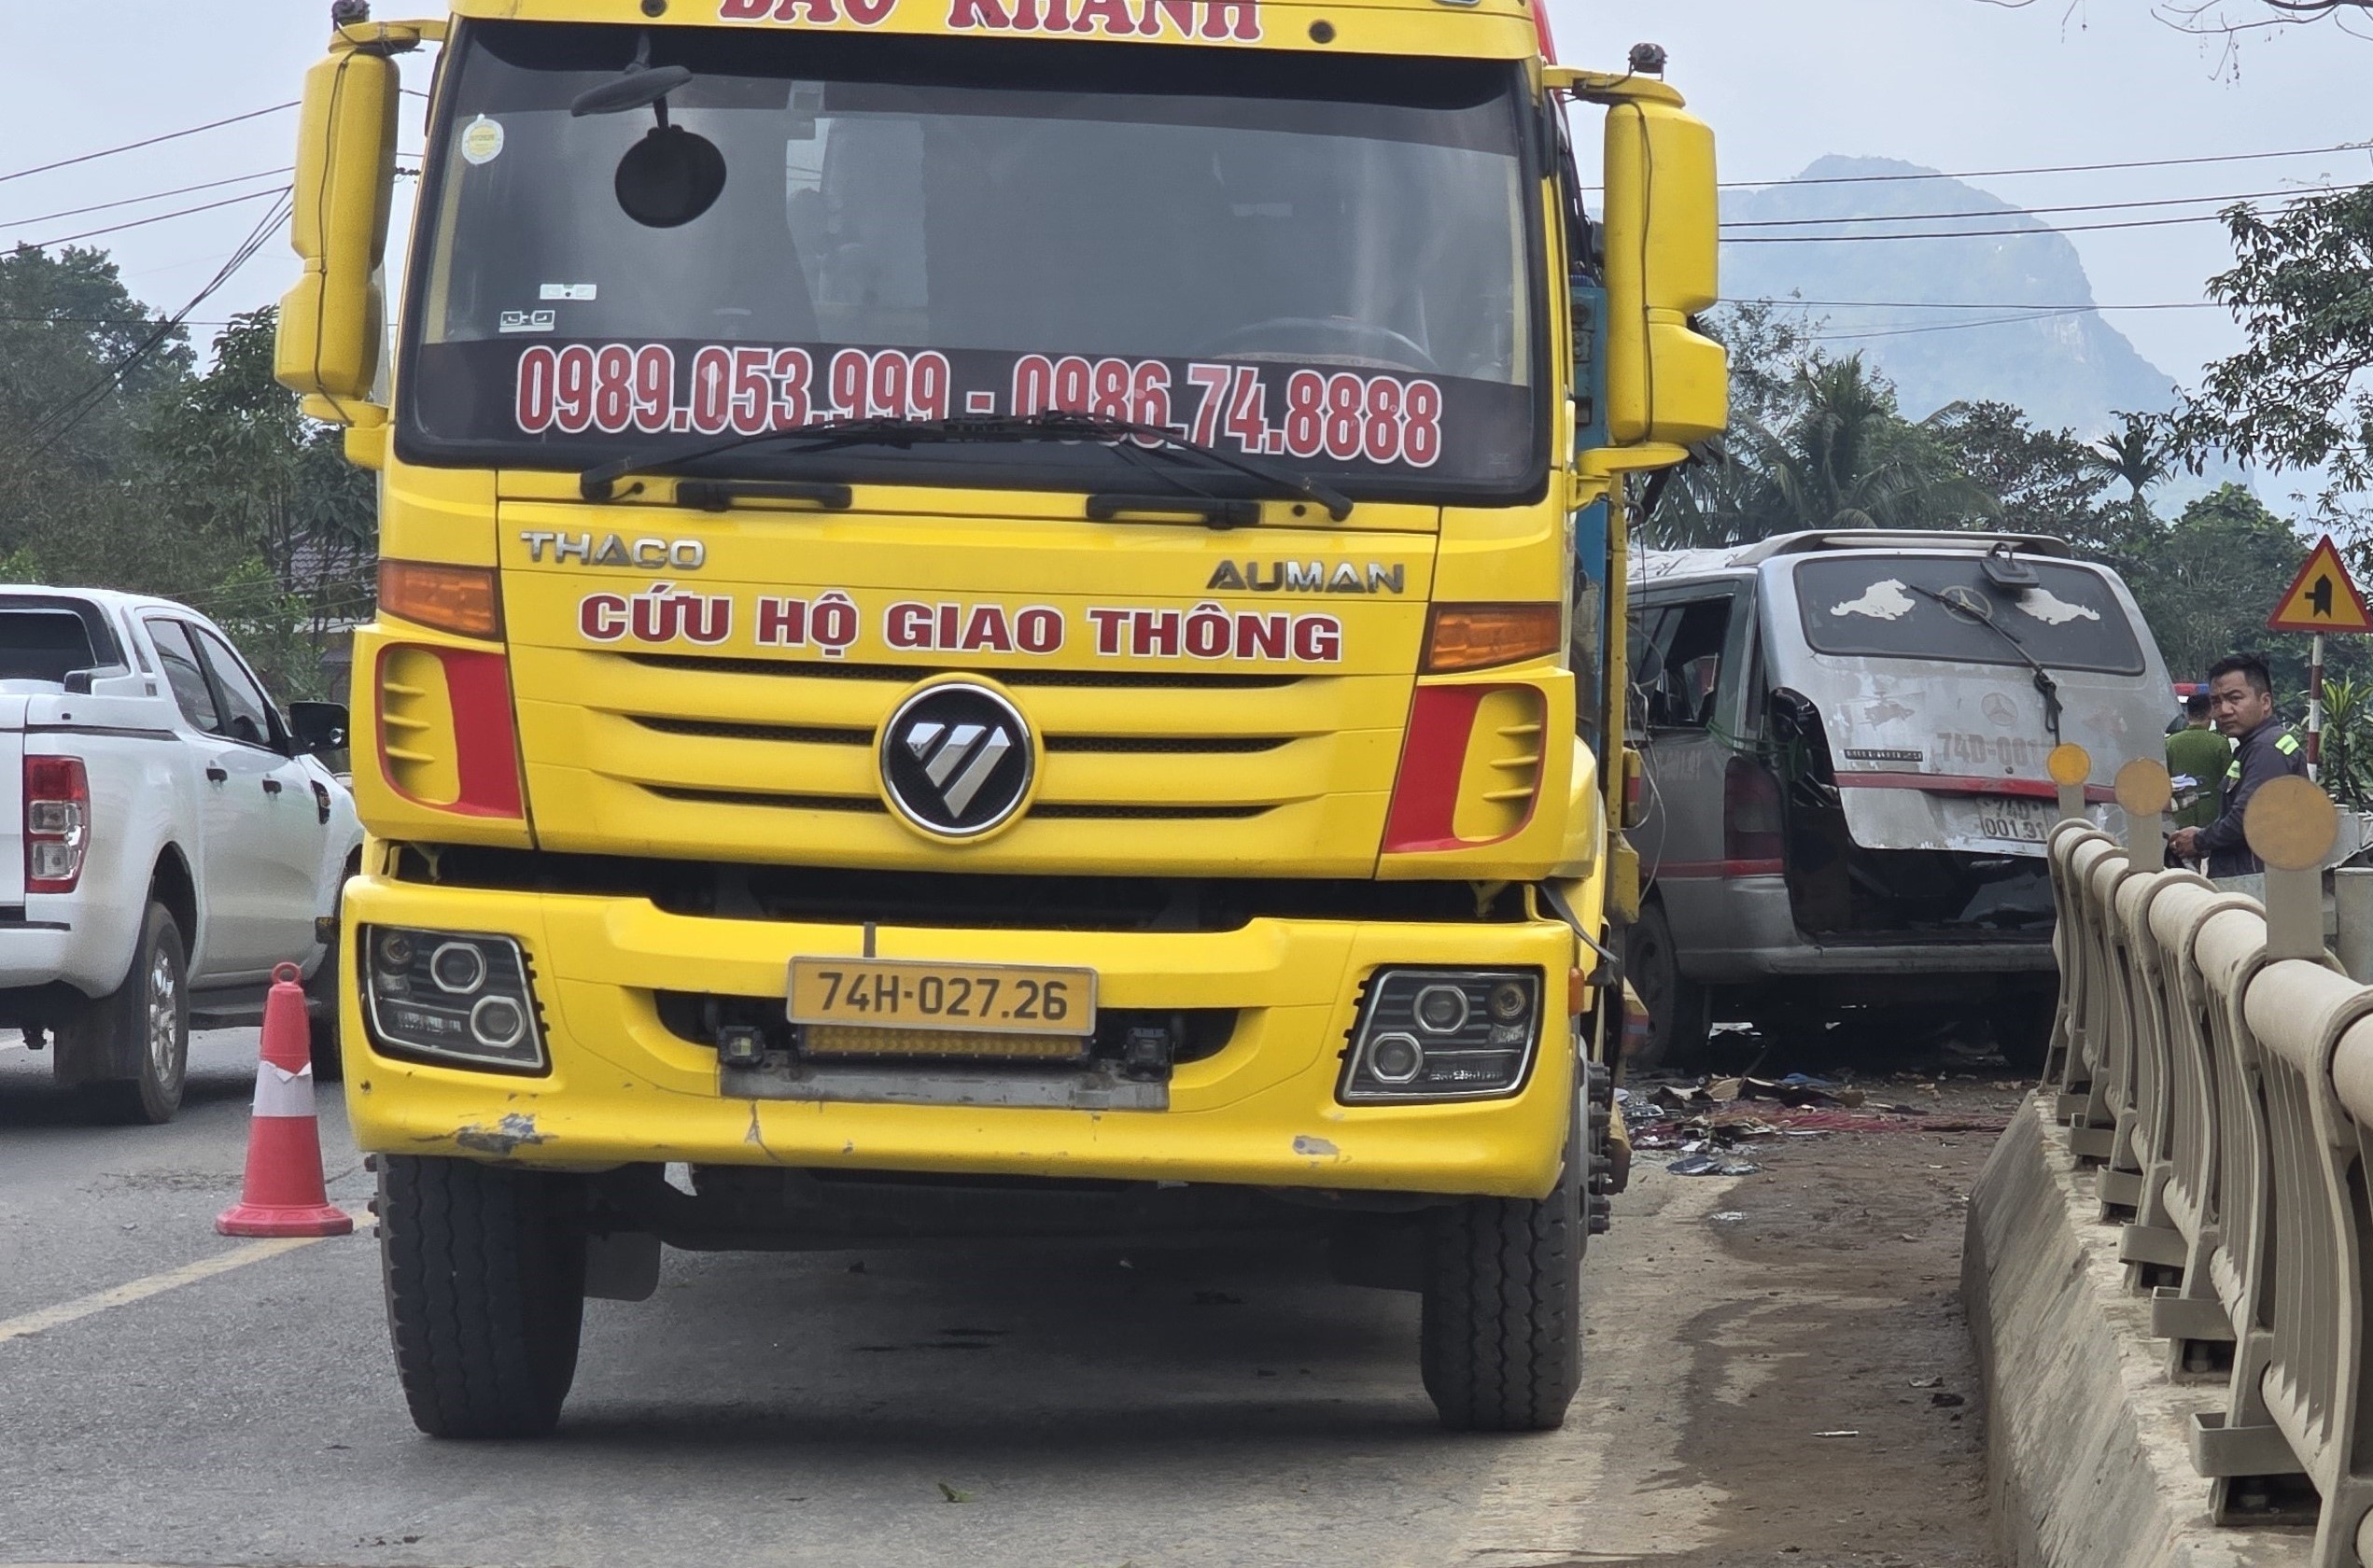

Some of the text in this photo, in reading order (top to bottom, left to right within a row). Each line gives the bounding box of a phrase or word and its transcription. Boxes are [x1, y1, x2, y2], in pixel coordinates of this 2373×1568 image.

[516, 343, 950, 435] 0989.053.999
[1011, 354, 1442, 468] 0986.74.8888
[520, 531, 706, 570] THACO
[1206, 560, 1404, 594] AUMAN
[578, 582, 1342, 663] CỨU HỘ GIAO THÔNG
[818, 972, 1068, 1021] 74H-027.26
